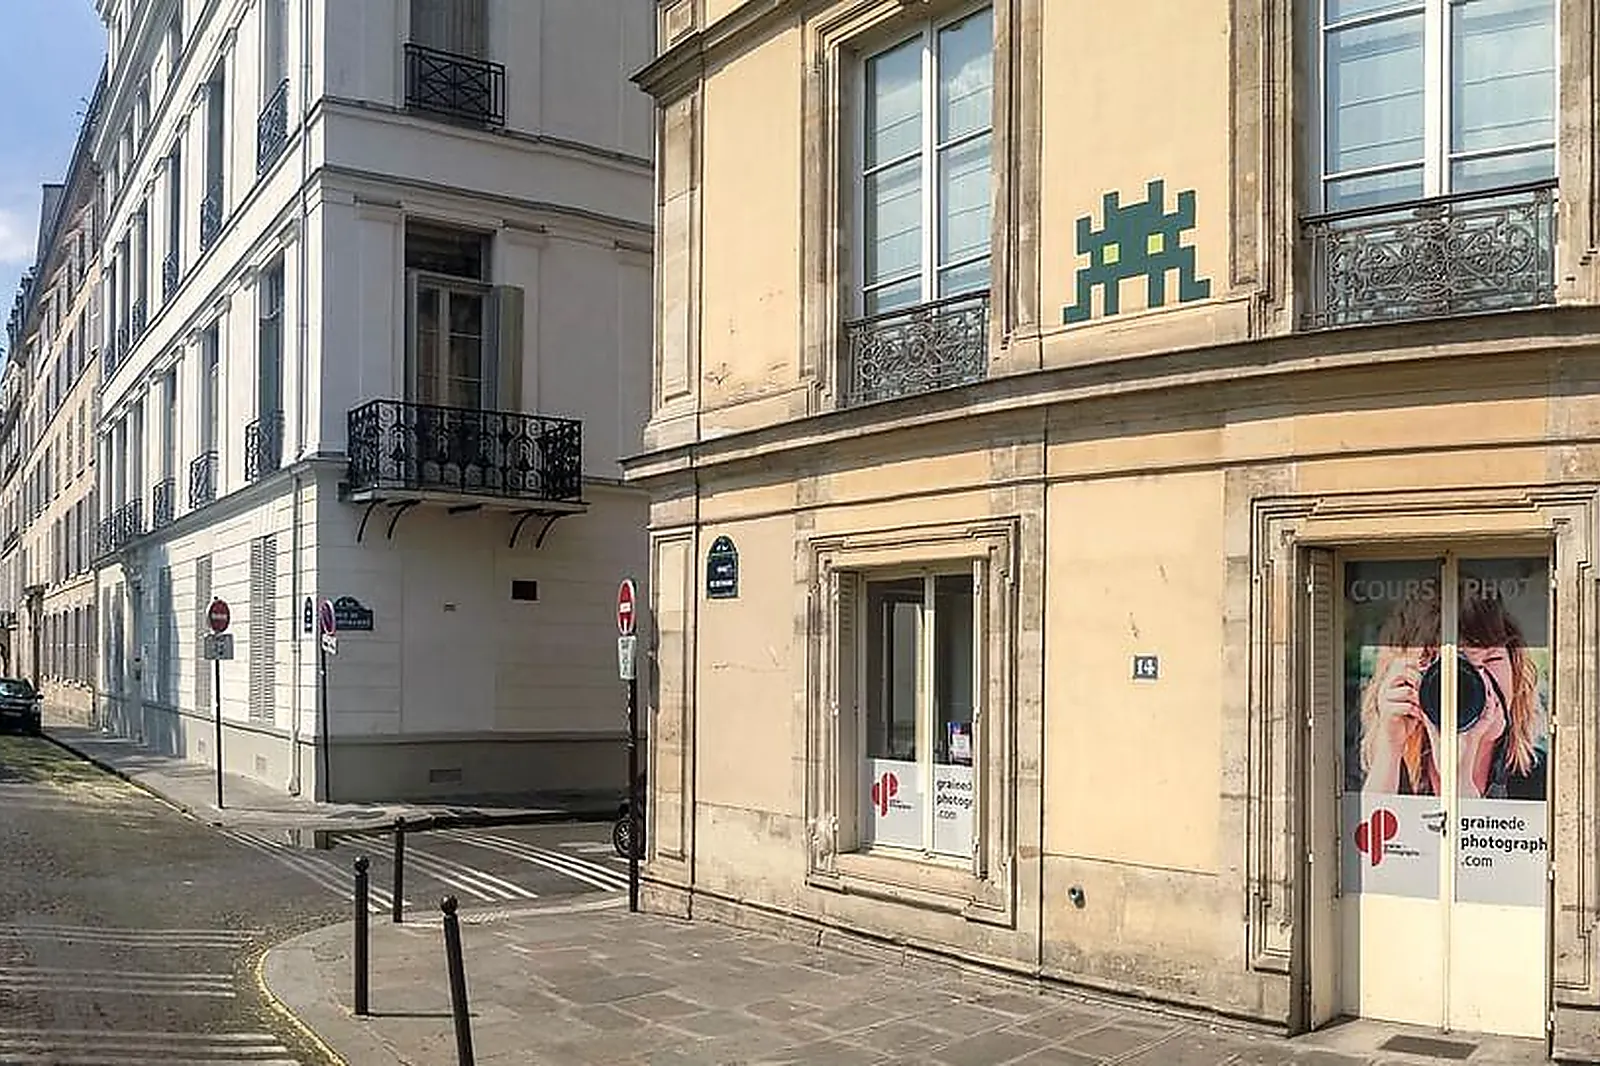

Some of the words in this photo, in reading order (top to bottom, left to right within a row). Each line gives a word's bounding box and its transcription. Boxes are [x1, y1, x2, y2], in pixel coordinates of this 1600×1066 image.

[1351, 579, 1436, 601] COURS
[1137, 659, 1155, 675] 14
[1461, 816, 1526, 831] grainede
[1461, 834, 1547, 853] photograph
[1461, 855, 1493, 867] .com
